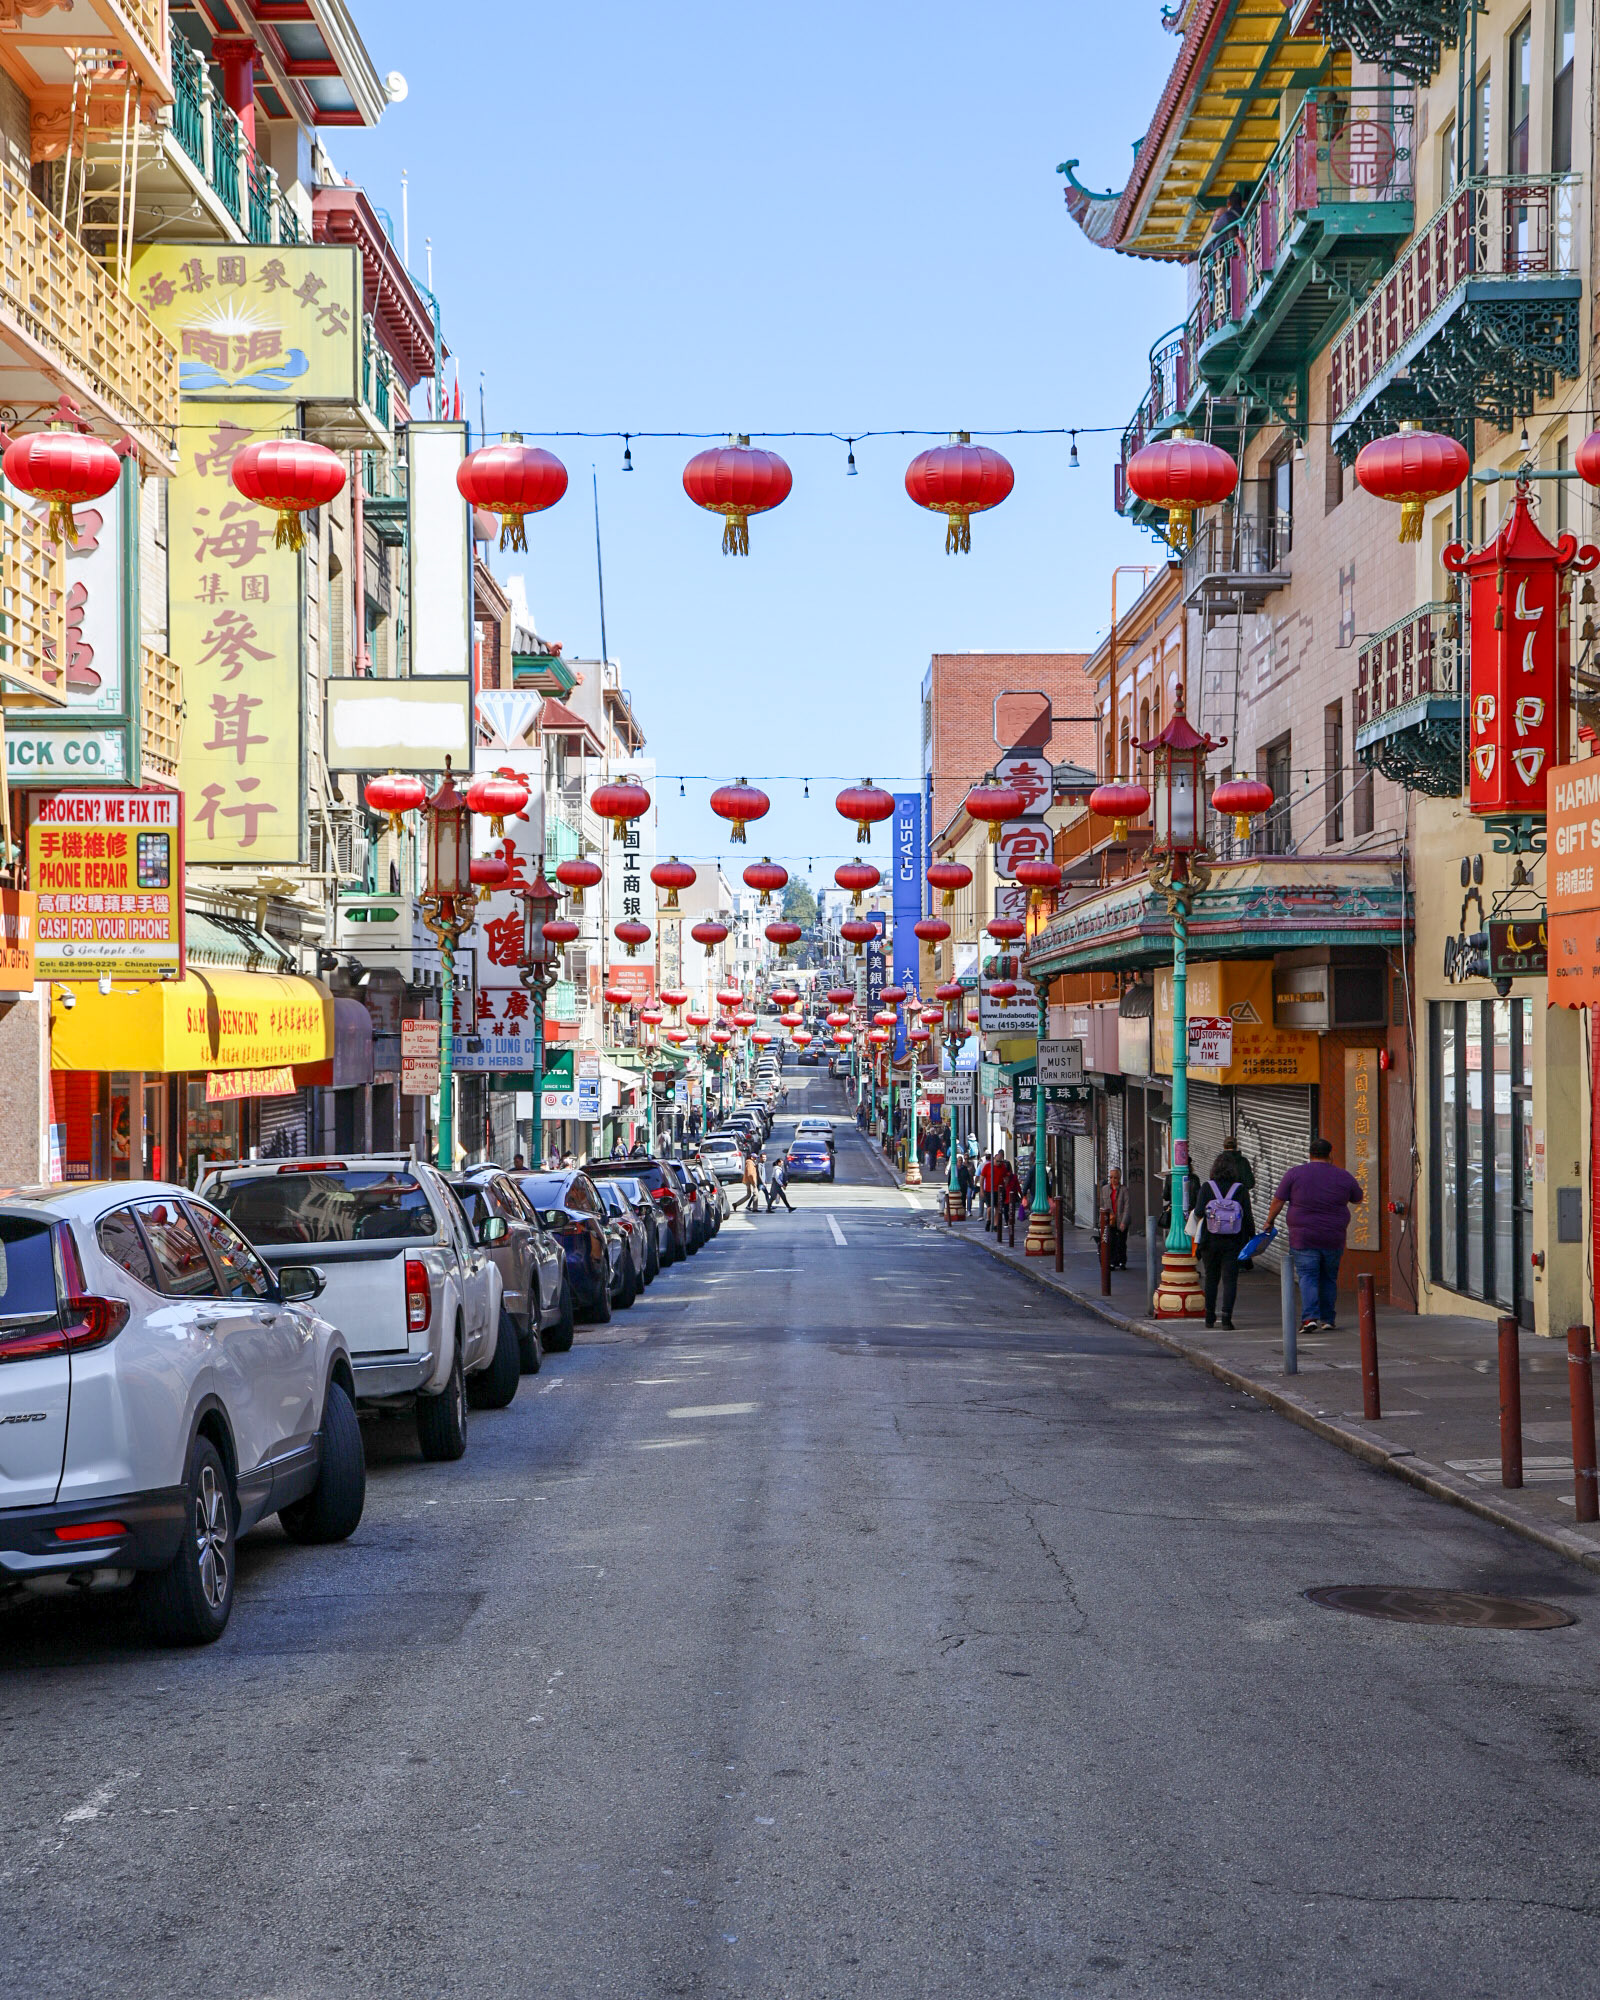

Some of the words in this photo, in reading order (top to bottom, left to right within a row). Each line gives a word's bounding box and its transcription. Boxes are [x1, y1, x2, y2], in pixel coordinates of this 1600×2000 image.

[137, 255, 348, 338] 海集團參茸行
[181, 327, 283, 372] 南海
[64, 740, 107, 767] CO.
[39, 799, 101, 823] BROKEN?
[105, 800, 124, 823] WE
[129, 800, 150, 823] FIX
[154, 800, 170, 823] IT!
[39, 831, 128, 859] 手機維修
[1556, 821, 1588, 856] GIFT
[901, 818, 914, 881] CHASE
[39, 862, 81, 888] PHONE
[85, 862, 128, 889] REPAIR
[37, 893, 170, 914] 高價收購蘋果手機
[38, 917, 69, 940] CASH
[71, 917, 94, 940] FOR
[96, 917, 127, 940] YOUR
[128, 917, 171, 940] IPHONE
[869, 940, 883, 1001] 華美銀行
[245, 1011, 258, 1036] INC
[403, 1022, 414, 1032] NO
[1189, 1029, 1200, 1039] NO
[1201, 1030, 1231, 1040] STOPPING
[496, 1038, 520, 1053] LUNG
[1040, 1045, 1059, 1053] RIGHT
[1061, 1045, 1079, 1053] LANE
[1200, 1051, 1219, 1060] TIME
[1202, 1041, 1218, 1050] ANY
[403, 1059, 414, 1070] NO
[415, 1062, 438, 1070] PARKING
[489, 1057, 524, 1066] HERBS
[1047, 1057, 1072, 1067] MUST
[1242, 1058, 1297, 1066] 415-956-5251
[1060, 1071, 1080, 1079] RIGHT
